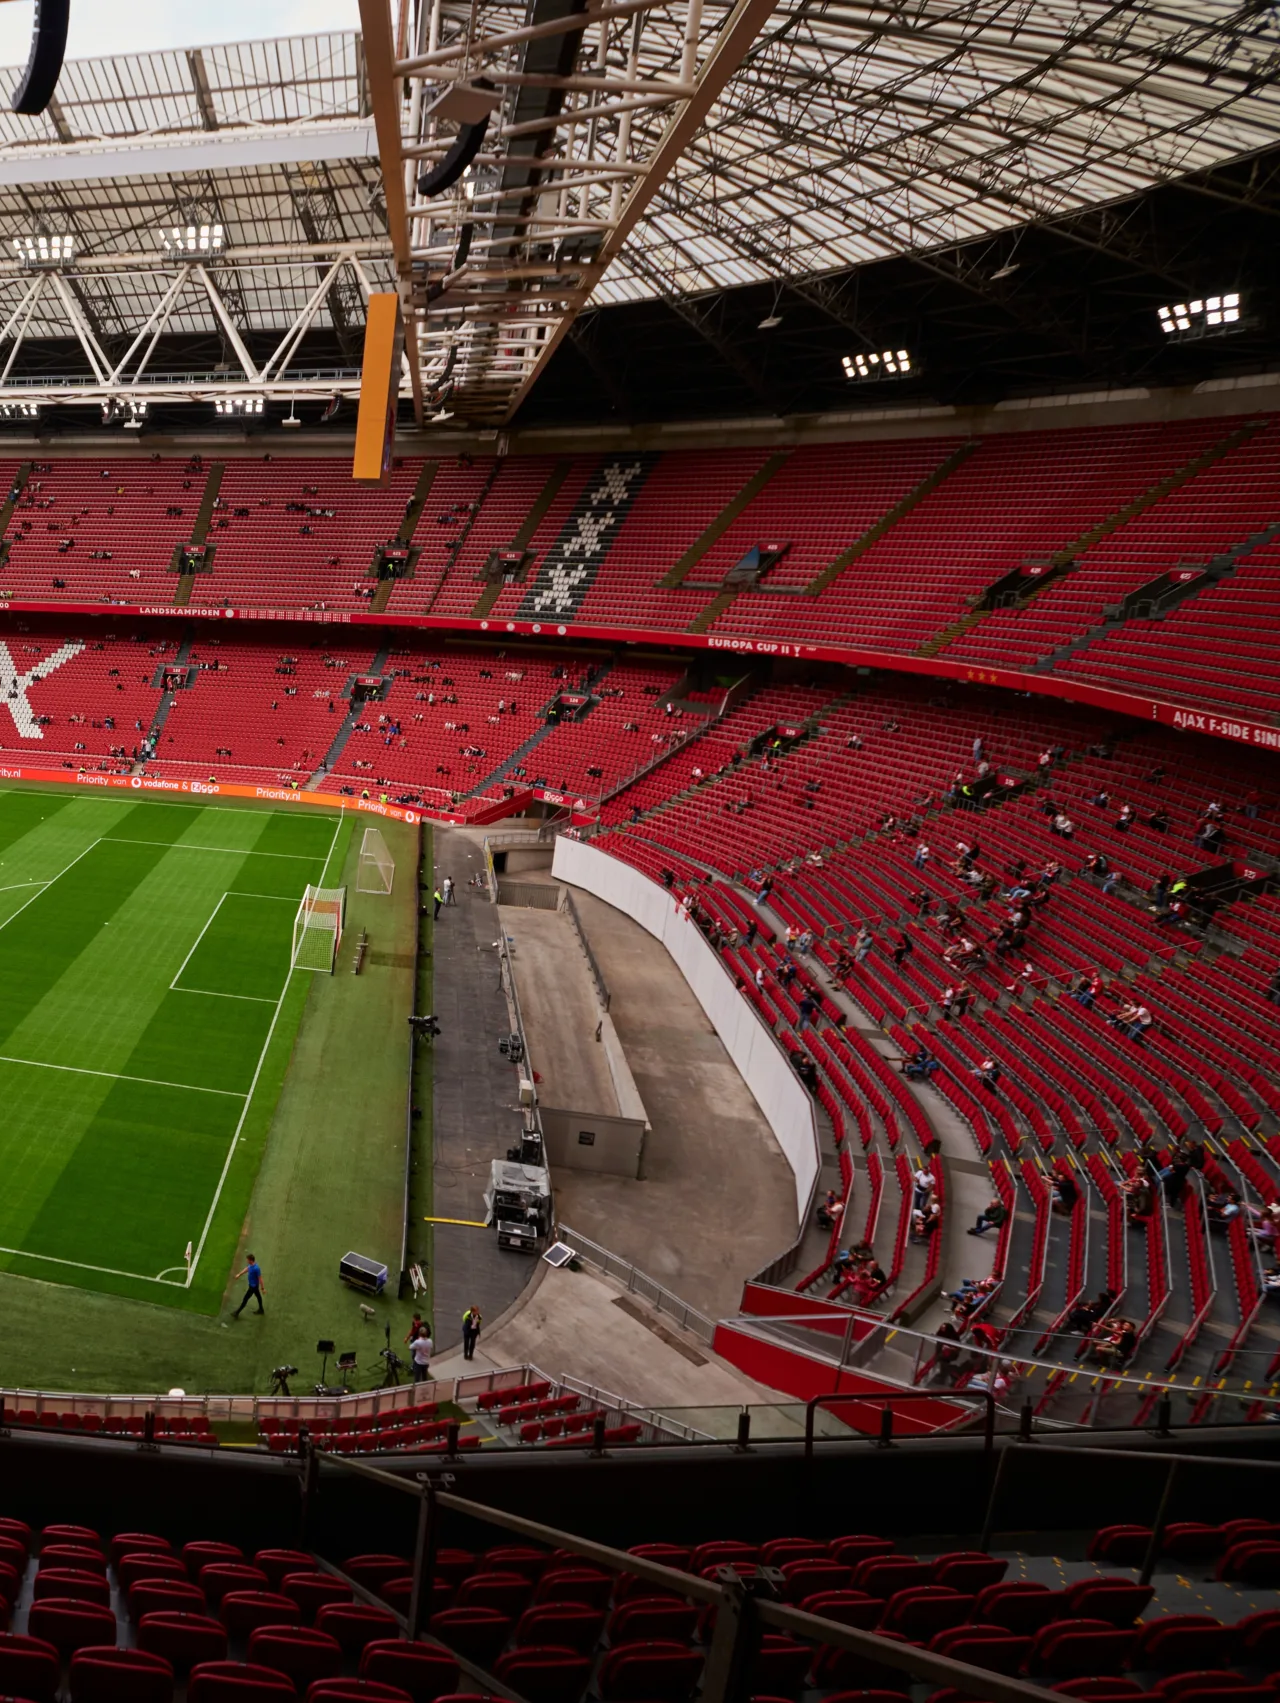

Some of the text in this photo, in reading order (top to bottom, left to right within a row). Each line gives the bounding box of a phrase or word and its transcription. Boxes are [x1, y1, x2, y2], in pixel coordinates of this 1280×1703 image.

[139, 607, 220, 616] LANDSKAMPIOEN
[708, 638, 753, 650] EUROPA
[756, 642, 778, 652] CUP
[781, 645, 789, 654] II
[1173, 711, 1205, 729] AJAX
[1209, 719, 1249, 740] F-SIDE
[76, 773, 109, 786] Priority
[143, 779, 179, 789] vodafone
[182, 782, 188, 790] &
[191, 781, 219, 794] Ziggo
[256, 787, 301, 801] Priority.nl
[544, 791, 563, 803] Ziggo
[358, 799, 388, 815] Priority
